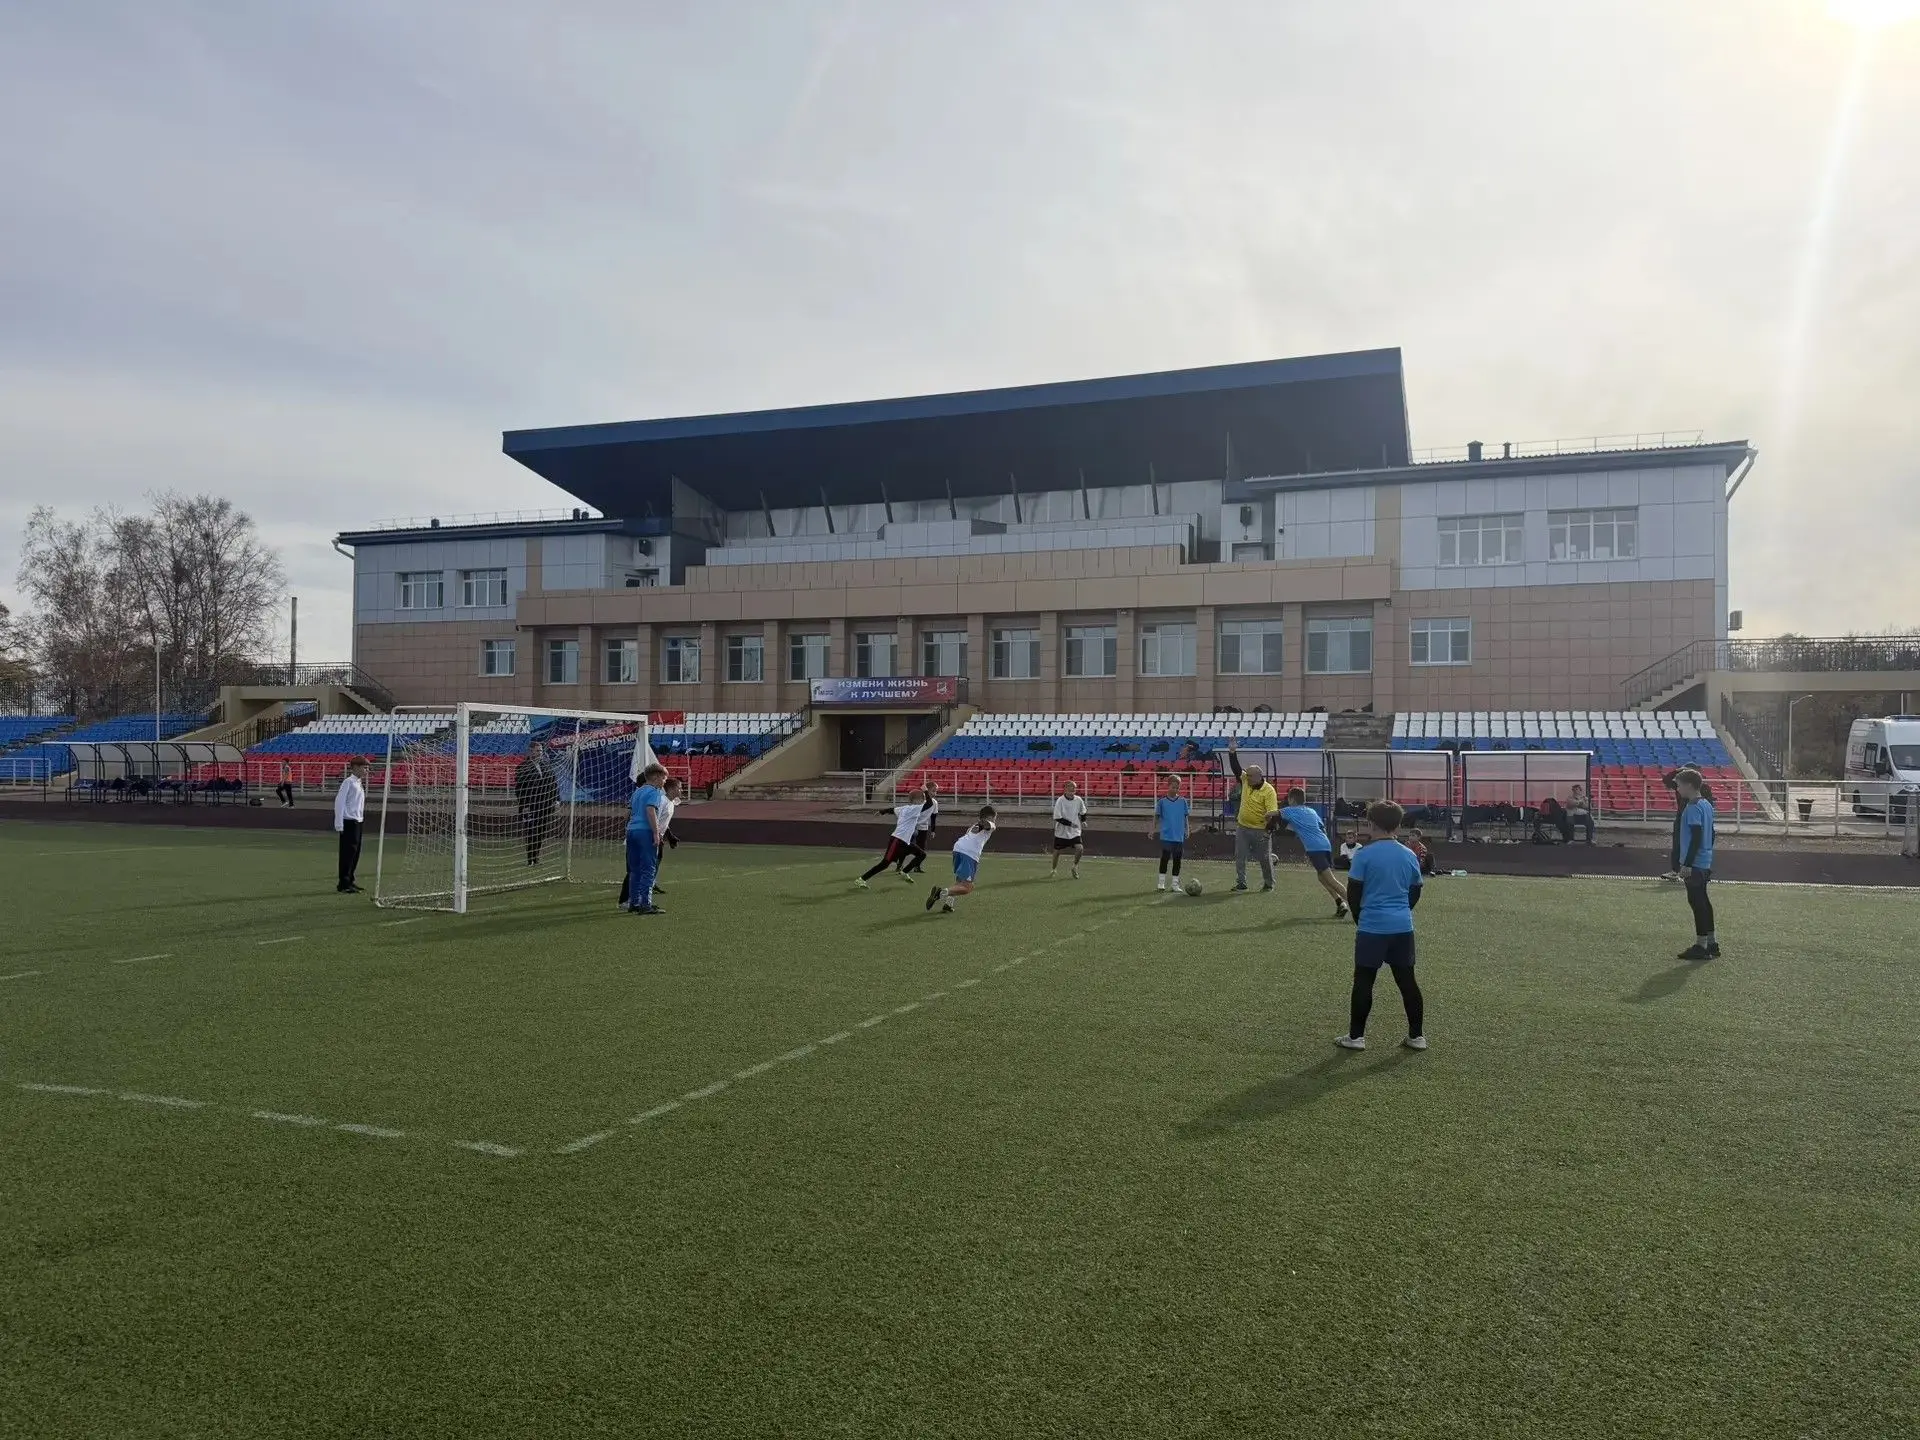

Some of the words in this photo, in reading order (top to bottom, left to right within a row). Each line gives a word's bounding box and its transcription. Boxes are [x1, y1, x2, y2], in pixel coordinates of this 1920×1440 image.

[838, 680, 884, 688] ИЗМЕНИ
[861, 690, 919, 698] ЛУЧШЕМУ
[608, 733, 637, 746] ВОСТОК
